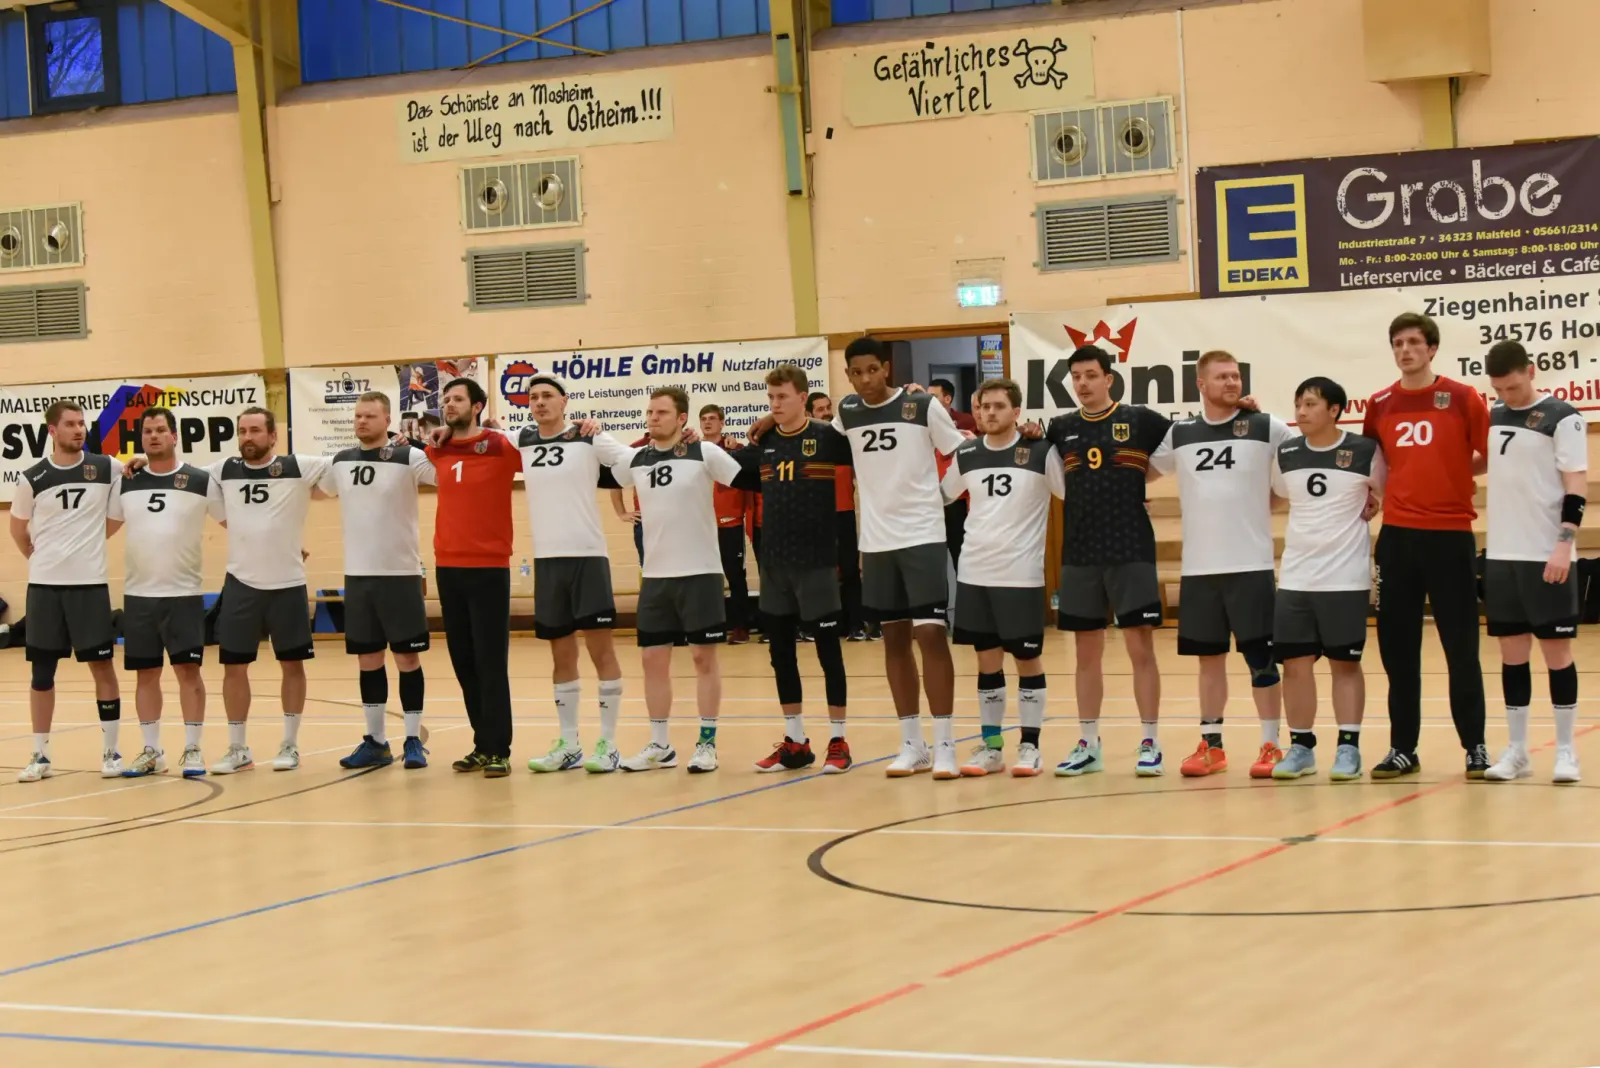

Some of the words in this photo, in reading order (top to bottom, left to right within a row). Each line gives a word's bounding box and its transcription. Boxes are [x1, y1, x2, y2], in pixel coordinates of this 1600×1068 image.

[874, 43, 1010, 82] Gefährliches
[407, 100, 433, 122] Das
[440, 90, 499, 117] Schönste
[508, 91, 525, 108] an
[530, 81, 594, 105] Mosheim
[909, 71, 992, 116] Viertel
[412, 127, 429, 153] ist
[438, 124, 459, 148] der
[464, 119, 502, 148] Weg
[514, 109, 553, 137] nach
[567, 88, 662, 133] Ostheim!!!
[1337, 159, 1562, 229] Grabe
[1338, 236, 1416, 249] Industriestraße
[1420, 235, 1426, 244] 7
[1439, 231, 1473, 243] 34323
[1476, 229, 1521, 240] Malsfeld
[1533, 223, 1598, 236] 05661/2314
[1339, 257, 1357, 265] Mo.
[1366, 256, 1382, 264] Fr.:
[1384, 251, 1439, 262] 8:00-20:00
[1441, 250, 1460, 259] Uhr
[1462, 249, 1470, 257] &
[1472, 247, 1518, 257] Samstag:
[1521, 242, 1578, 253] 8:00-18:00
[1580, 241, 1599, 250] Uhr
[1227, 266, 1299, 283] EDEKA
[1340, 268, 1443, 287] Lieferservice
[1464, 260, 1537, 279] Bäckerei
[1542, 259, 1556, 274] &
[1423, 290, 1590, 320] Ziegenhainer
[1479, 321, 1553, 345] 34576
[552, 355, 633, 379] HÖHLE
[641, 352, 714, 375] GmbH
[125, 388, 256, 408] BAUTENSCHUTZ
[588, 388, 644, 399] Leistungen
[692, 383, 717, 393] PKW
[722, 382, 740, 392] und
[509, 413, 524, 422] HU
[569, 411, 588, 420] alle
[590, 409, 642, 419] Fahrzeuge
[2, 423, 103, 460] SVN
[861, 428, 897, 452] 25
[1395, 420, 1433, 447] 20
[1500, 430, 1516, 455] 7
[531, 446, 564, 467] 23
[1087, 447, 1102, 469] 9
[1195, 446, 1236, 471] 24
[350, 465, 375, 486] 10
[450, 461, 463, 482] 1
[646, 465, 672, 488] 18
[776, 461, 794, 481] 11
[239, 483, 269, 504] 15
[981, 474, 1012, 497] 13
[1307, 473, 1327, 497] 6
[55, 488, 87, 509] 17
[147, 493, 166, 513] 5
